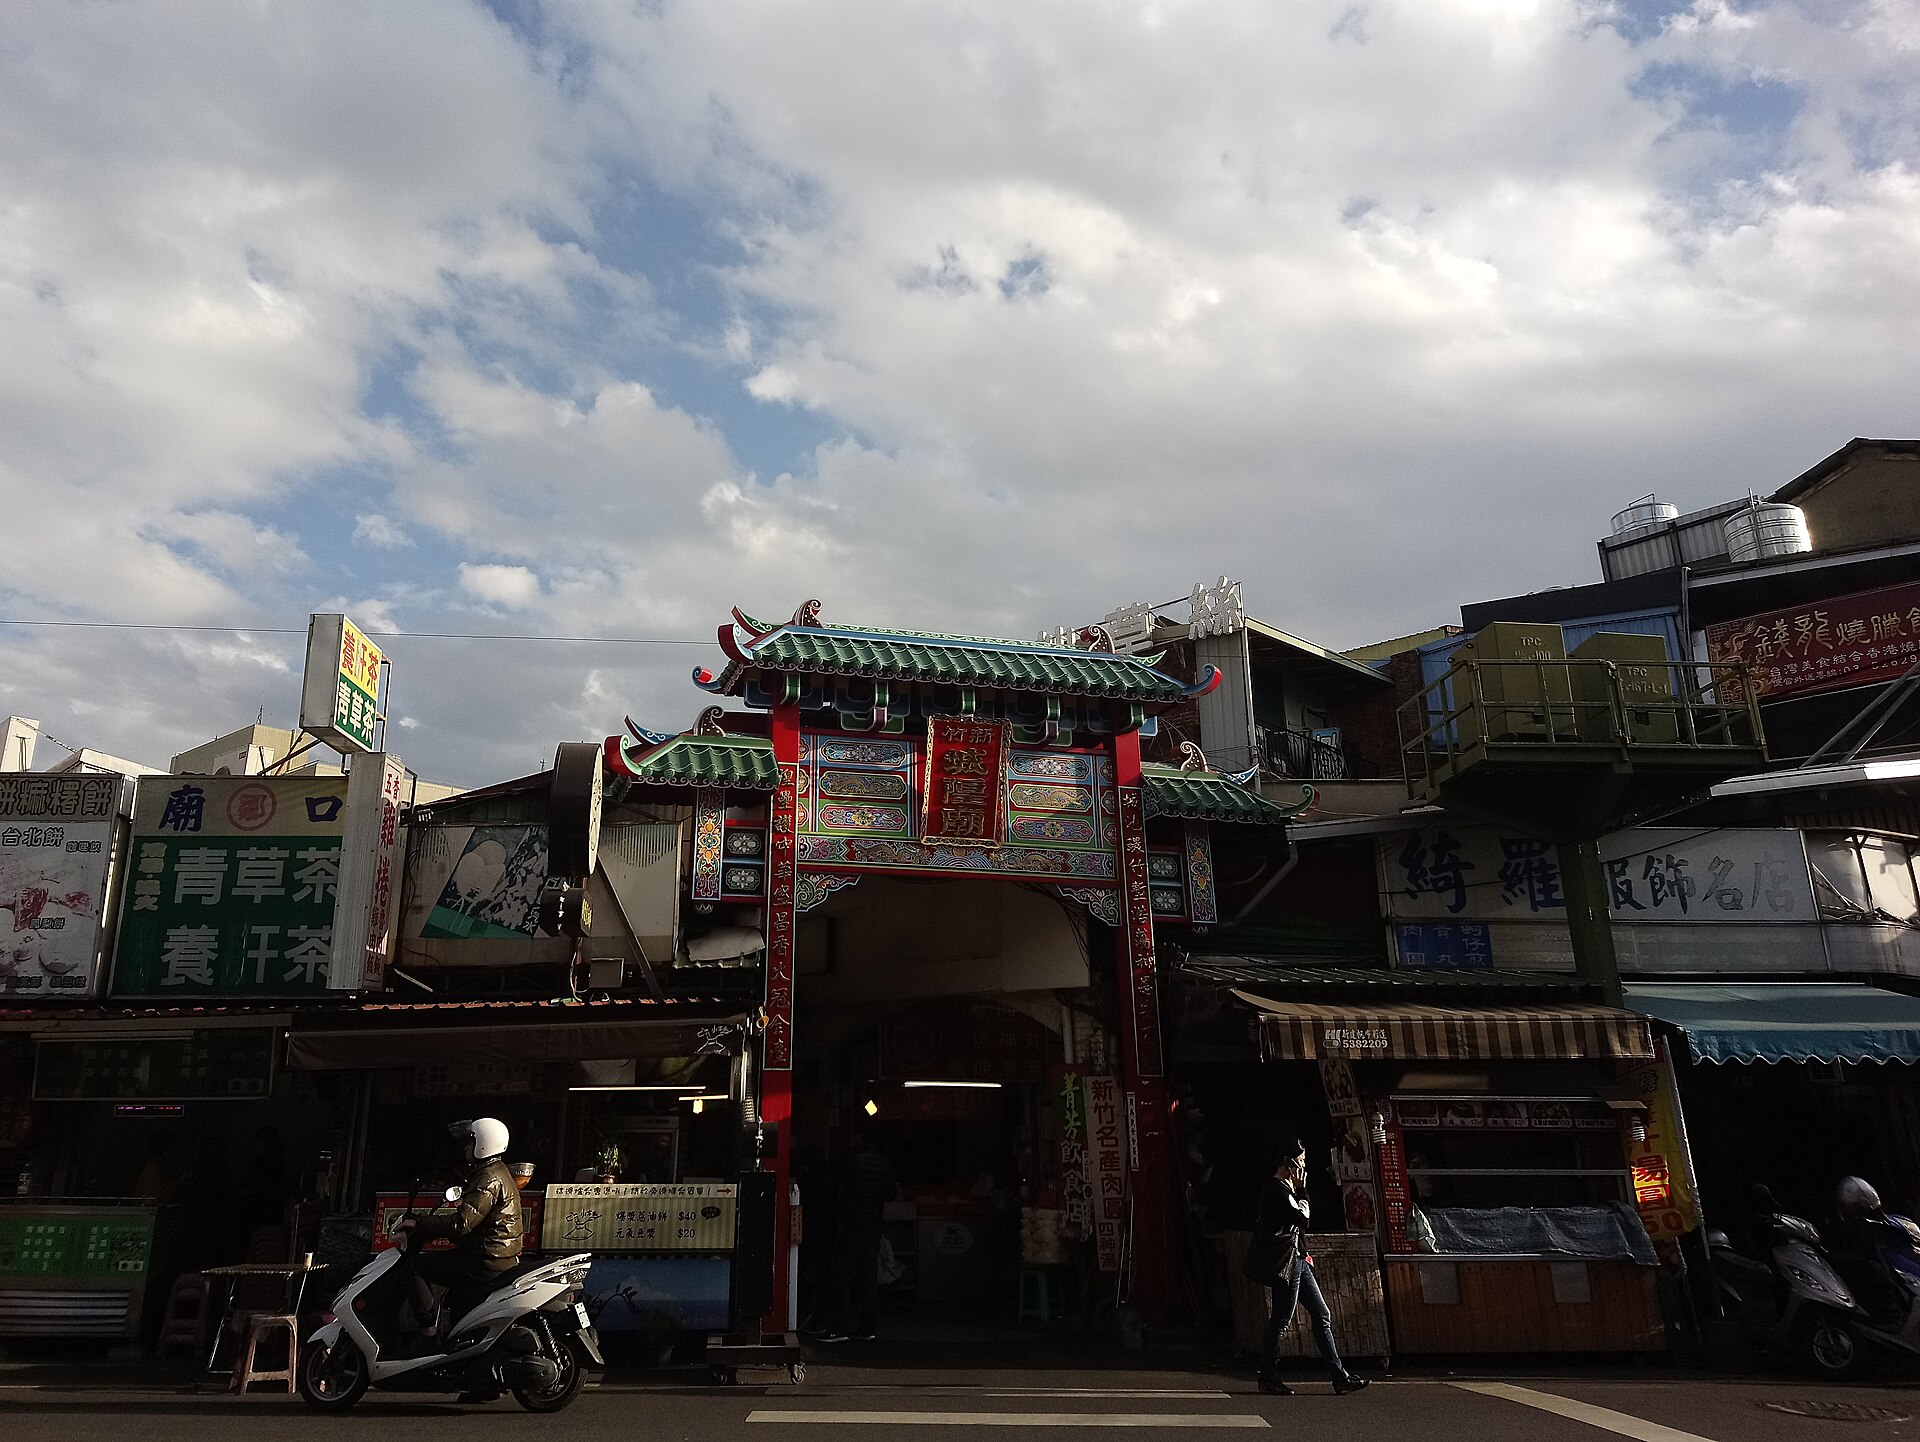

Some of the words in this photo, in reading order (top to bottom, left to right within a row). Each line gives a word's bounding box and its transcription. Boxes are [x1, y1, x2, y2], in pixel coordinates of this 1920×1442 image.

[1520, 636, 1542, 647] TPC
[1769, 640, 1920, 678] 台灣美食結合香港燒
[1626, 667, 1648, 677] TPC
[337, 681, 375, 743] 青草茶
[940, 747, 989, 837] 城隍廟
[2, 827, 64, 847] 台北餅
[173, 846, 341, 905] 青草茶
[1342, 1040, 1388, 1049] 5382209
[1091, 1079, 1123, 1221] 新竹名產肉圓
[677, 1210, 697, 1222] $40
[676, 1227, 696, 1239] $20
